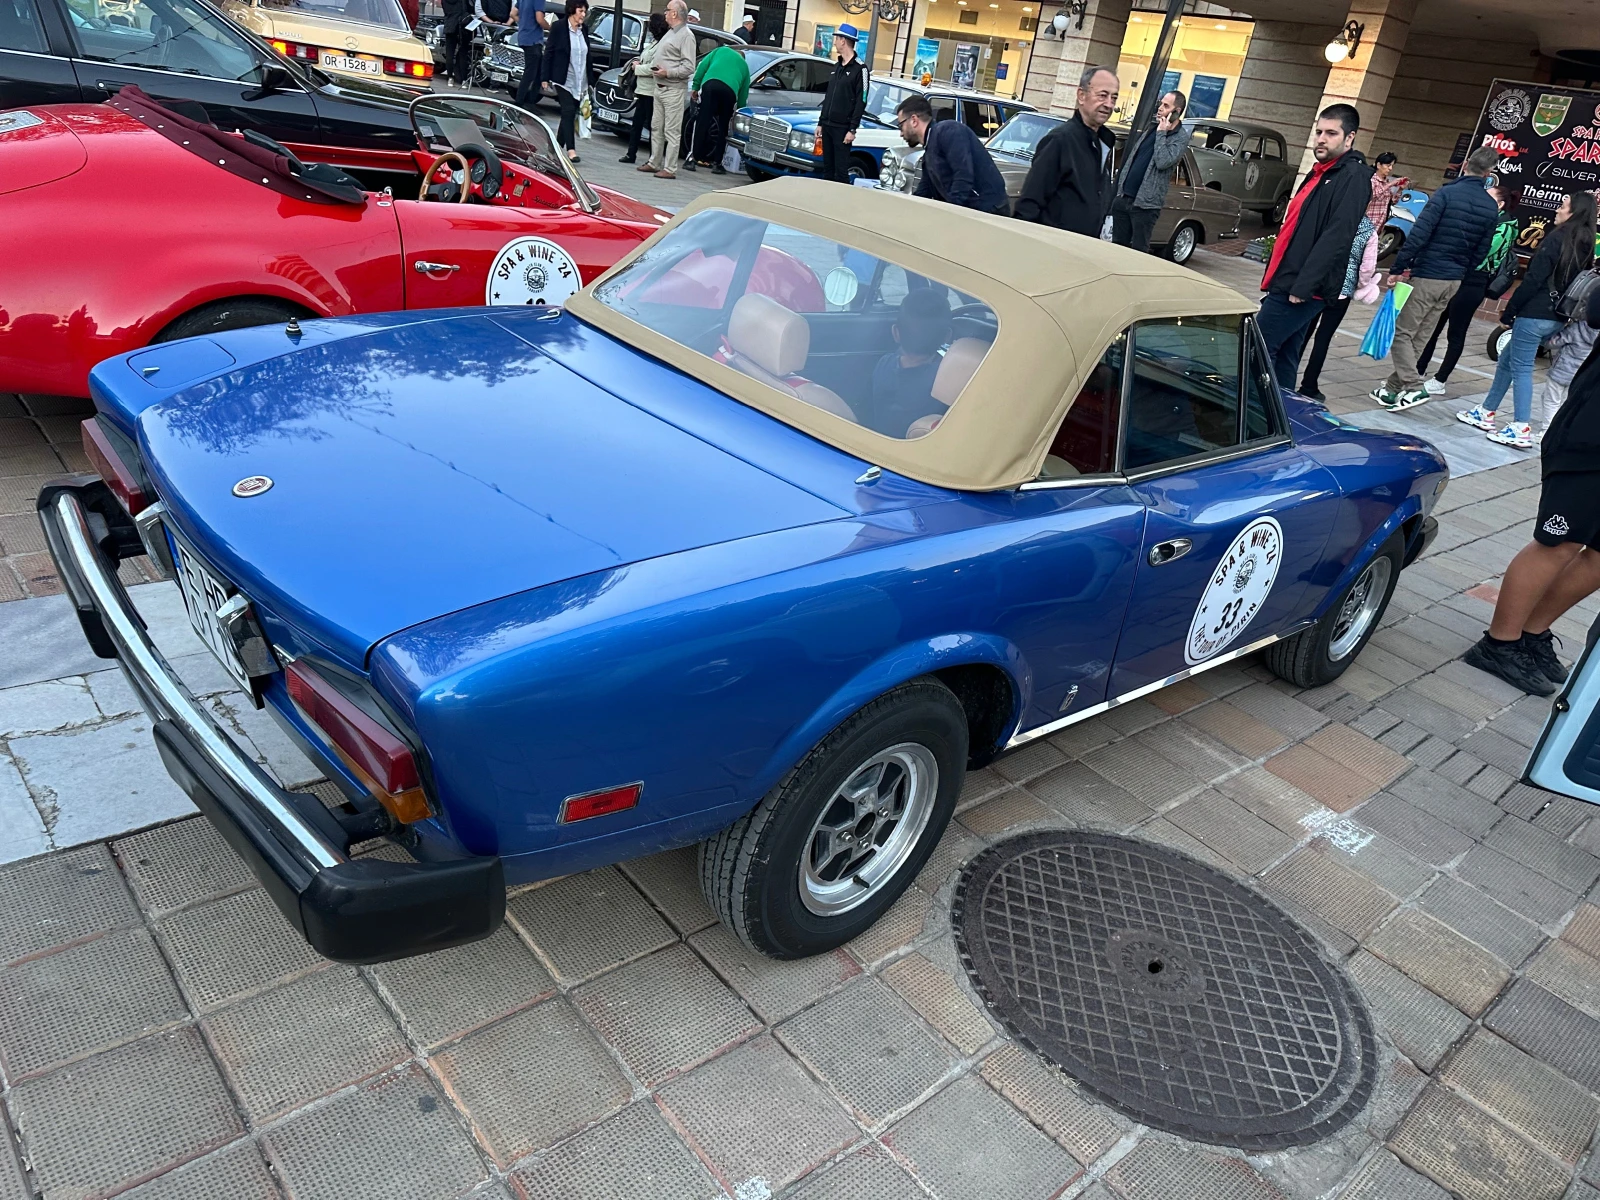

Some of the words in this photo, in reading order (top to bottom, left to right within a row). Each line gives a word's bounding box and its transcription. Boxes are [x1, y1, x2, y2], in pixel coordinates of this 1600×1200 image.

[1572, 125, 1593, 139] SPA
[1482, 133, 1516, 151] Piros
[1551, 167, 1597, 182] SILVER
[1520, 198, 1541, 207] GRAND
[1522, 185, 1570, 202] Therme
[497, 256, 517, 280] SPA
[514, 248, 525, 262] &
[527, 244, 557, 264] WINE
[1215, 554, 1236, 586] SPA
[1238, 540, 1246, 557] &
[1250, 528, 1273, 550] WINE
[1213, 597, 1244, 634] 33
[1230, 602, 1257, 636] PIRIN
